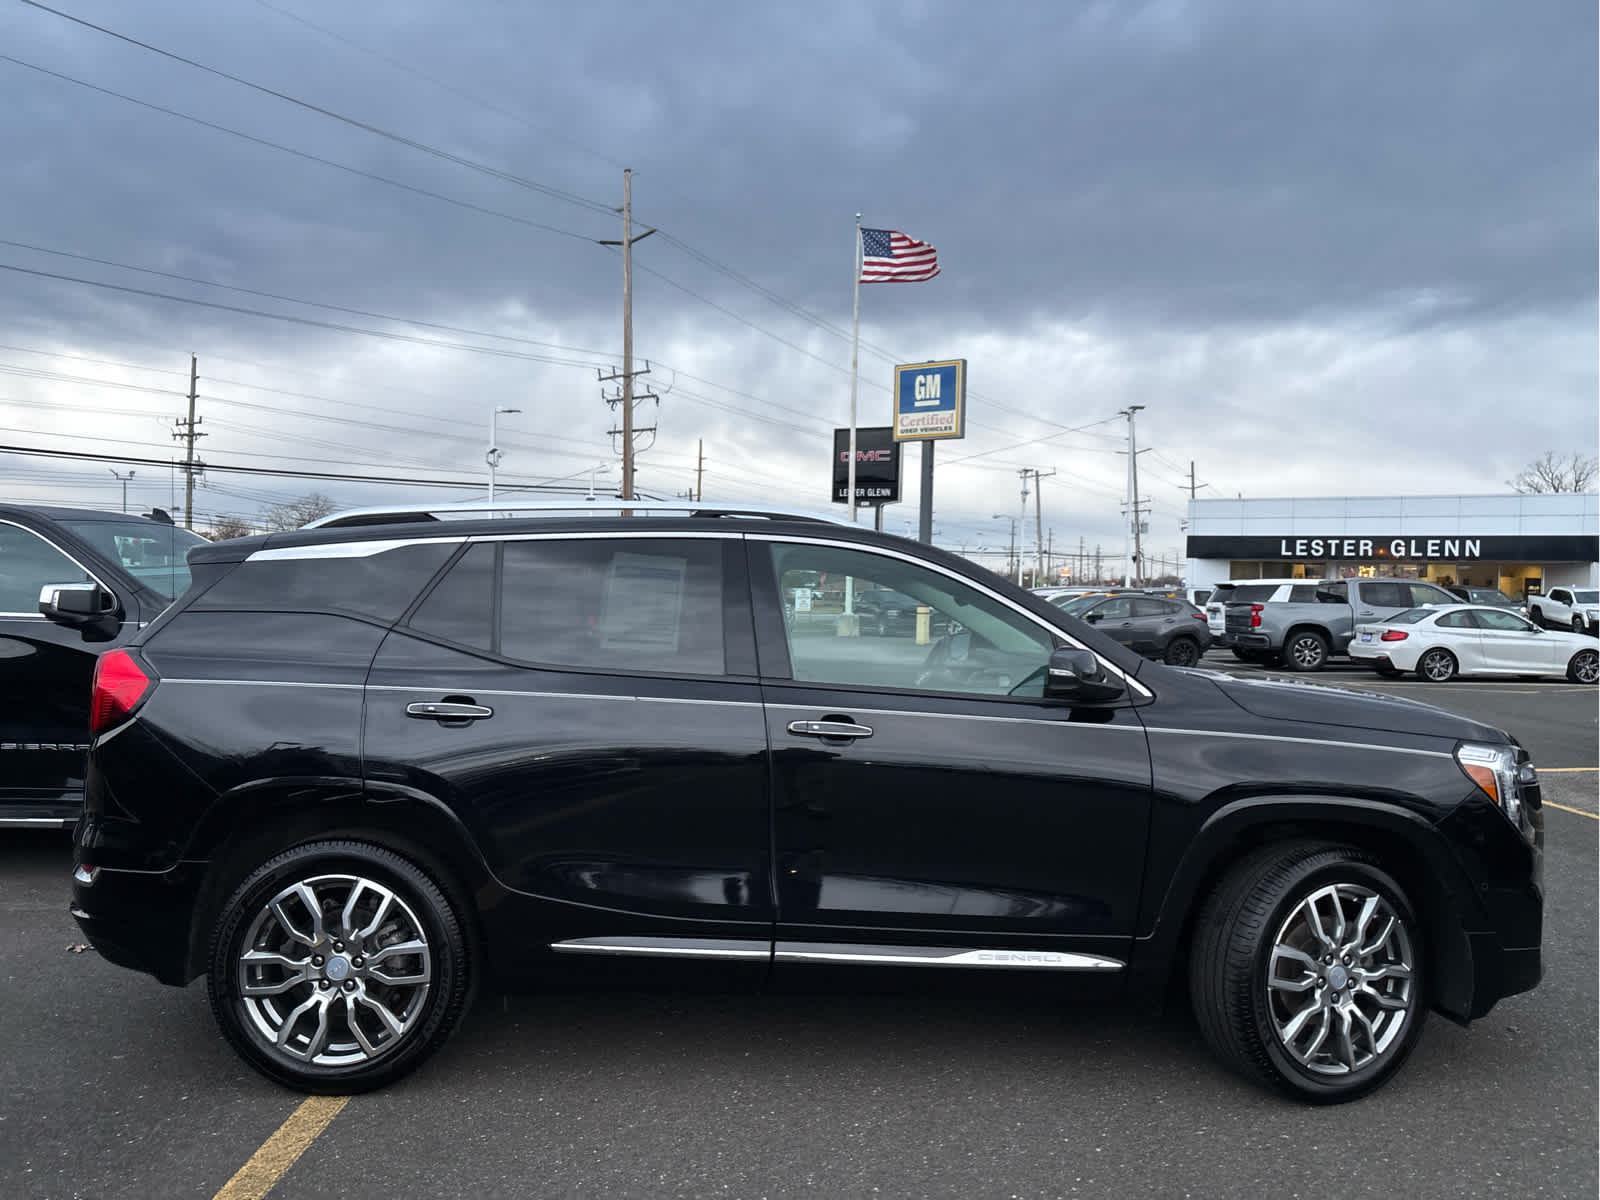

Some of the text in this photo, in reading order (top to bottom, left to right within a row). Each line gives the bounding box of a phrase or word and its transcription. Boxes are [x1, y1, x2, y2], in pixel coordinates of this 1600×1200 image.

[914, 374, 941, 401] GM
[899, 413, 954, 427] Certified
[839, 488, 891, 497] LEER GLENN
[1280, 539, 1481, 557] LESTER GLENN
[978, 953, 1062, 962] DENALI
